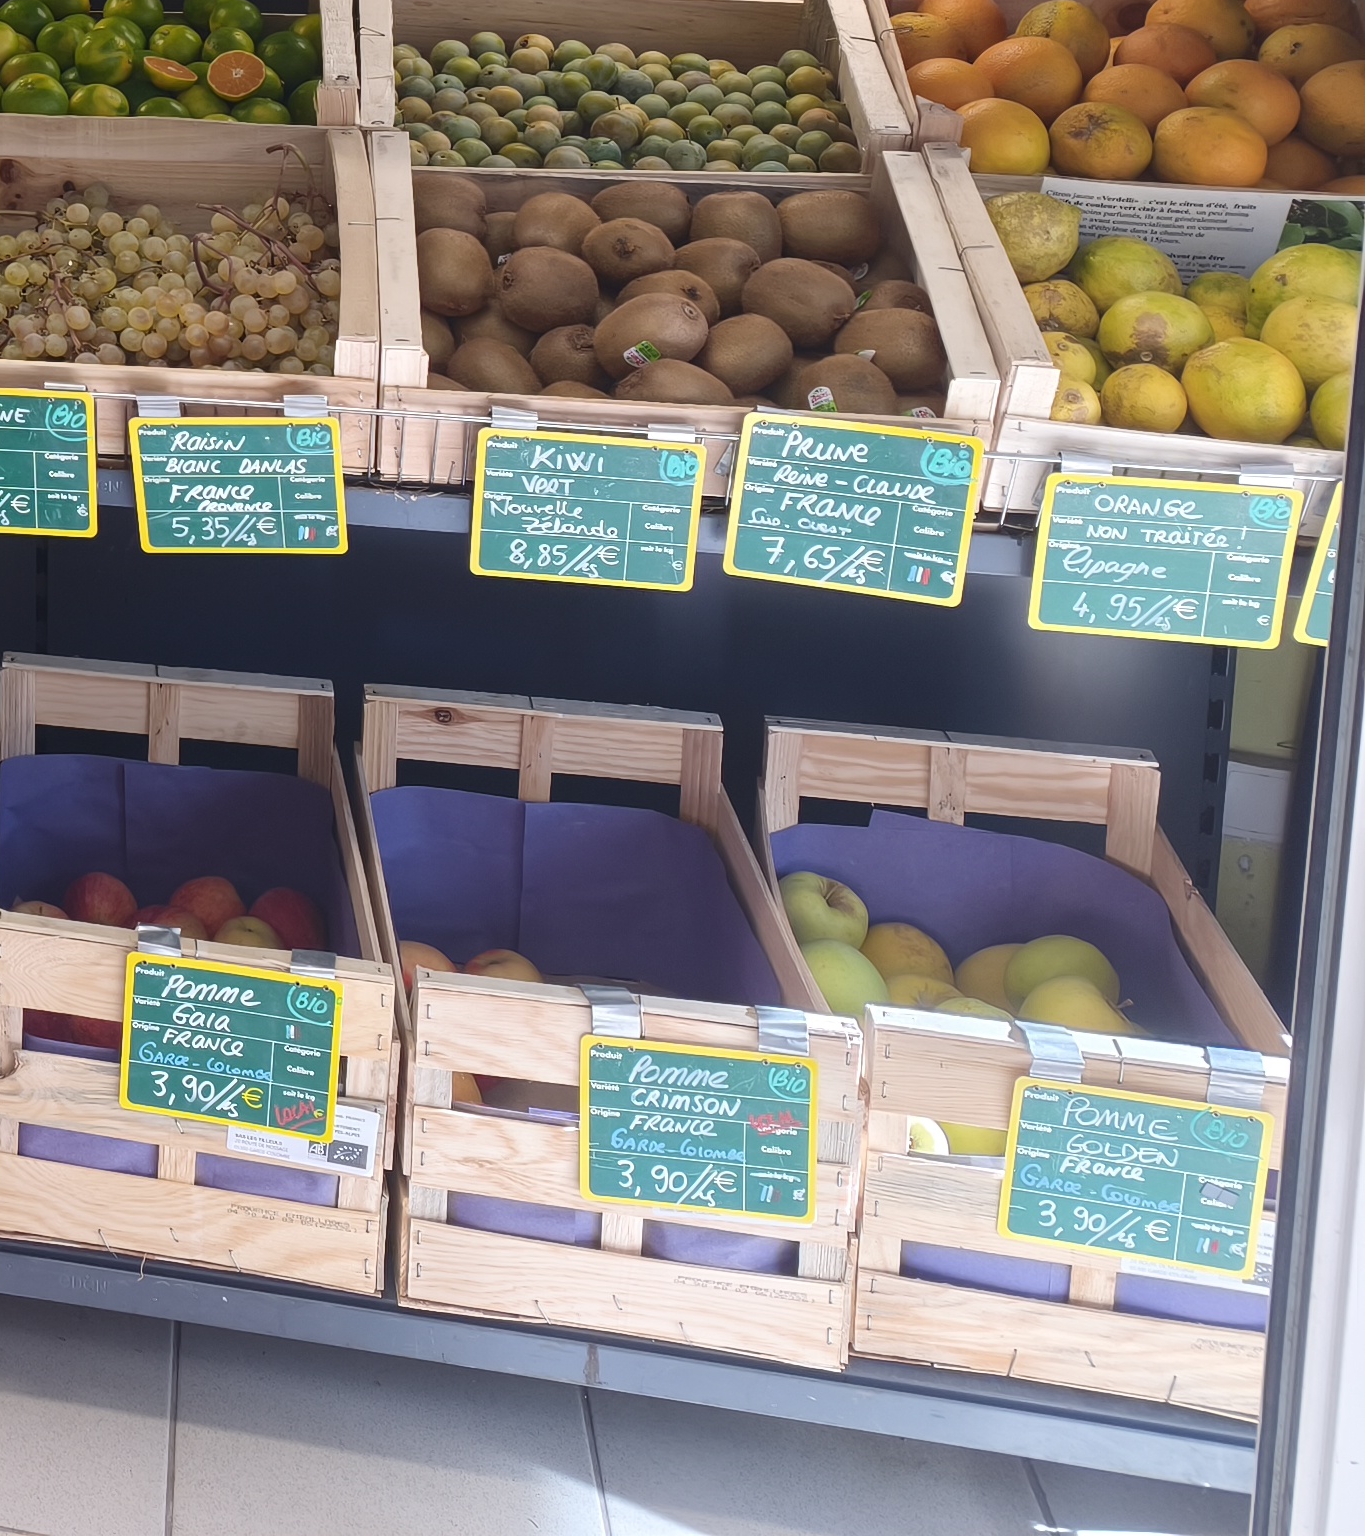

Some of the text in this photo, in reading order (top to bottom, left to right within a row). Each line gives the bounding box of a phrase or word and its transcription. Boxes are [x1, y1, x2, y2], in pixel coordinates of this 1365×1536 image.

[239, 457, 308, 475] DANLAS
[529, 444, 605, 474] KIWI
[489, 499, 584, 520] Nouvelle
[1085, 524, 1129, 540] NON
[630, 1086, 742, 1119] CRIMSON
[1062, 1096, 1181, 1141] POMME
[1066, 1131, 1180, 1168] GOLDEN
